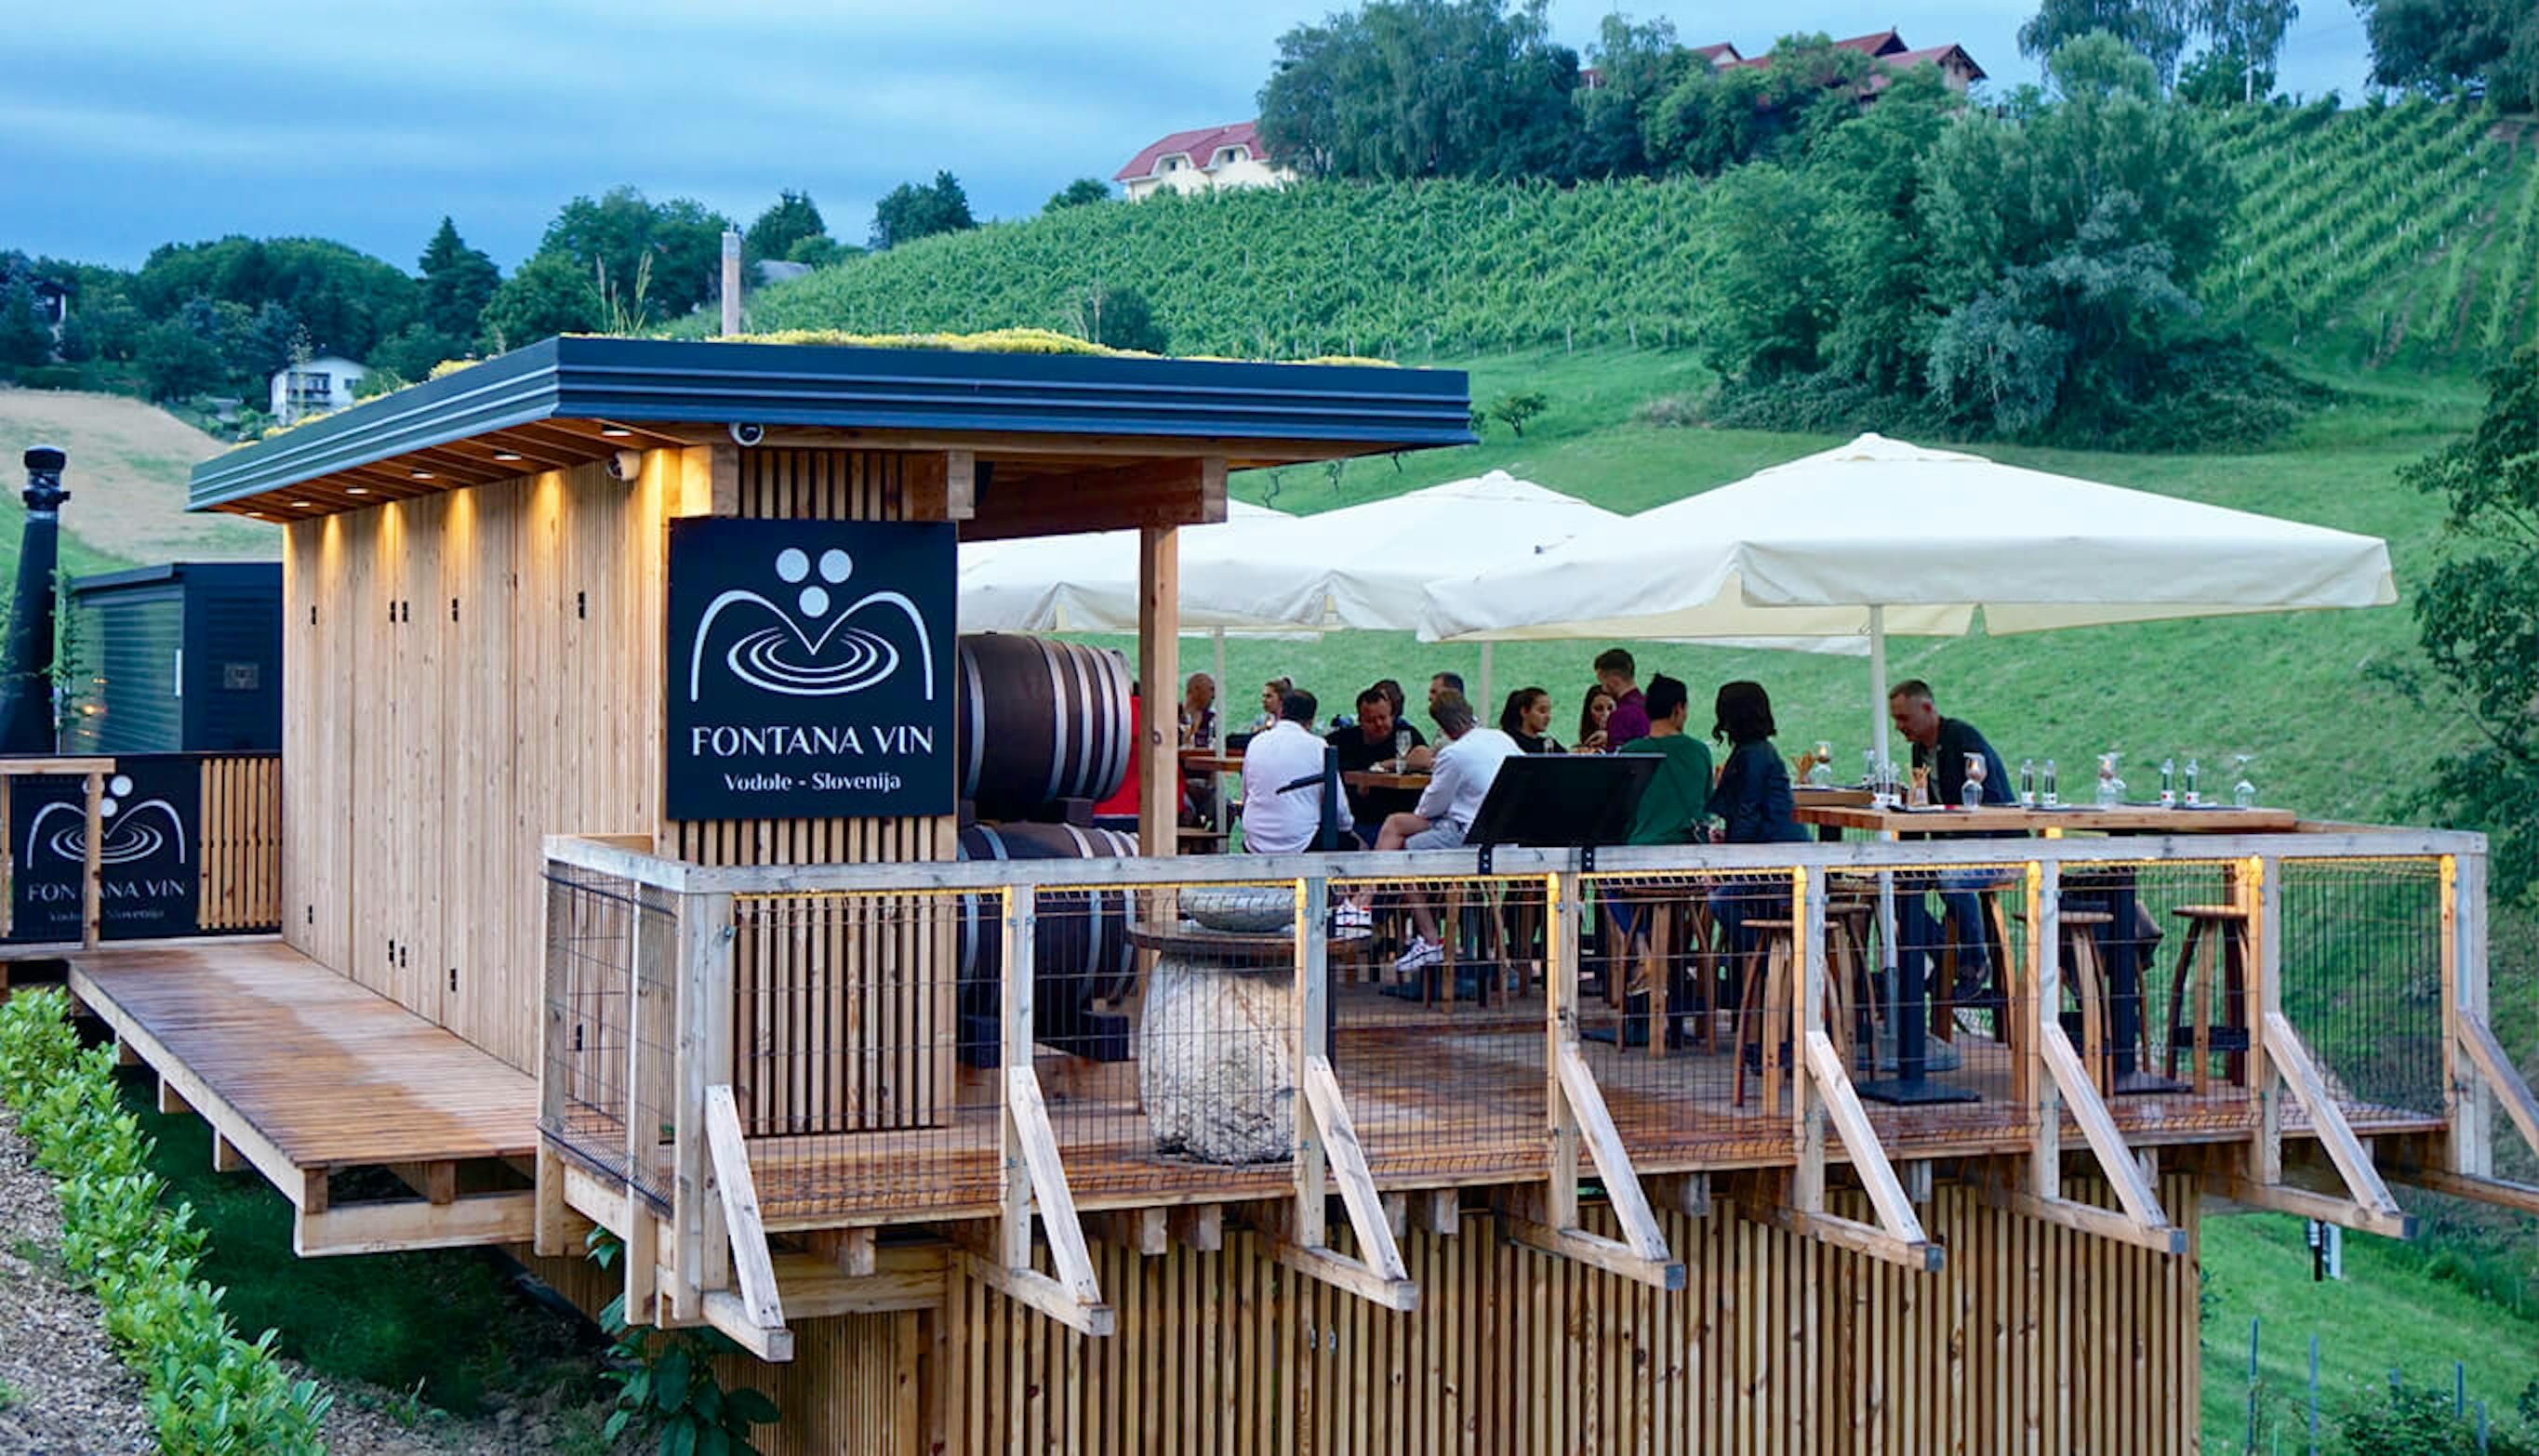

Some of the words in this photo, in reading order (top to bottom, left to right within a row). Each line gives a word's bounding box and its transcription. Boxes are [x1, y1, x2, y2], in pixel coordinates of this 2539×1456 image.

[691, 725, 864, 757] FONTANA
[871, 725, 933, 756] VIN
[724, 772, 791, 792] Vodole
[812, 771, 902, 793] Slovenija
[28, 880, 141, 902] FONNA
[144, 879, 186, 898] VIN
